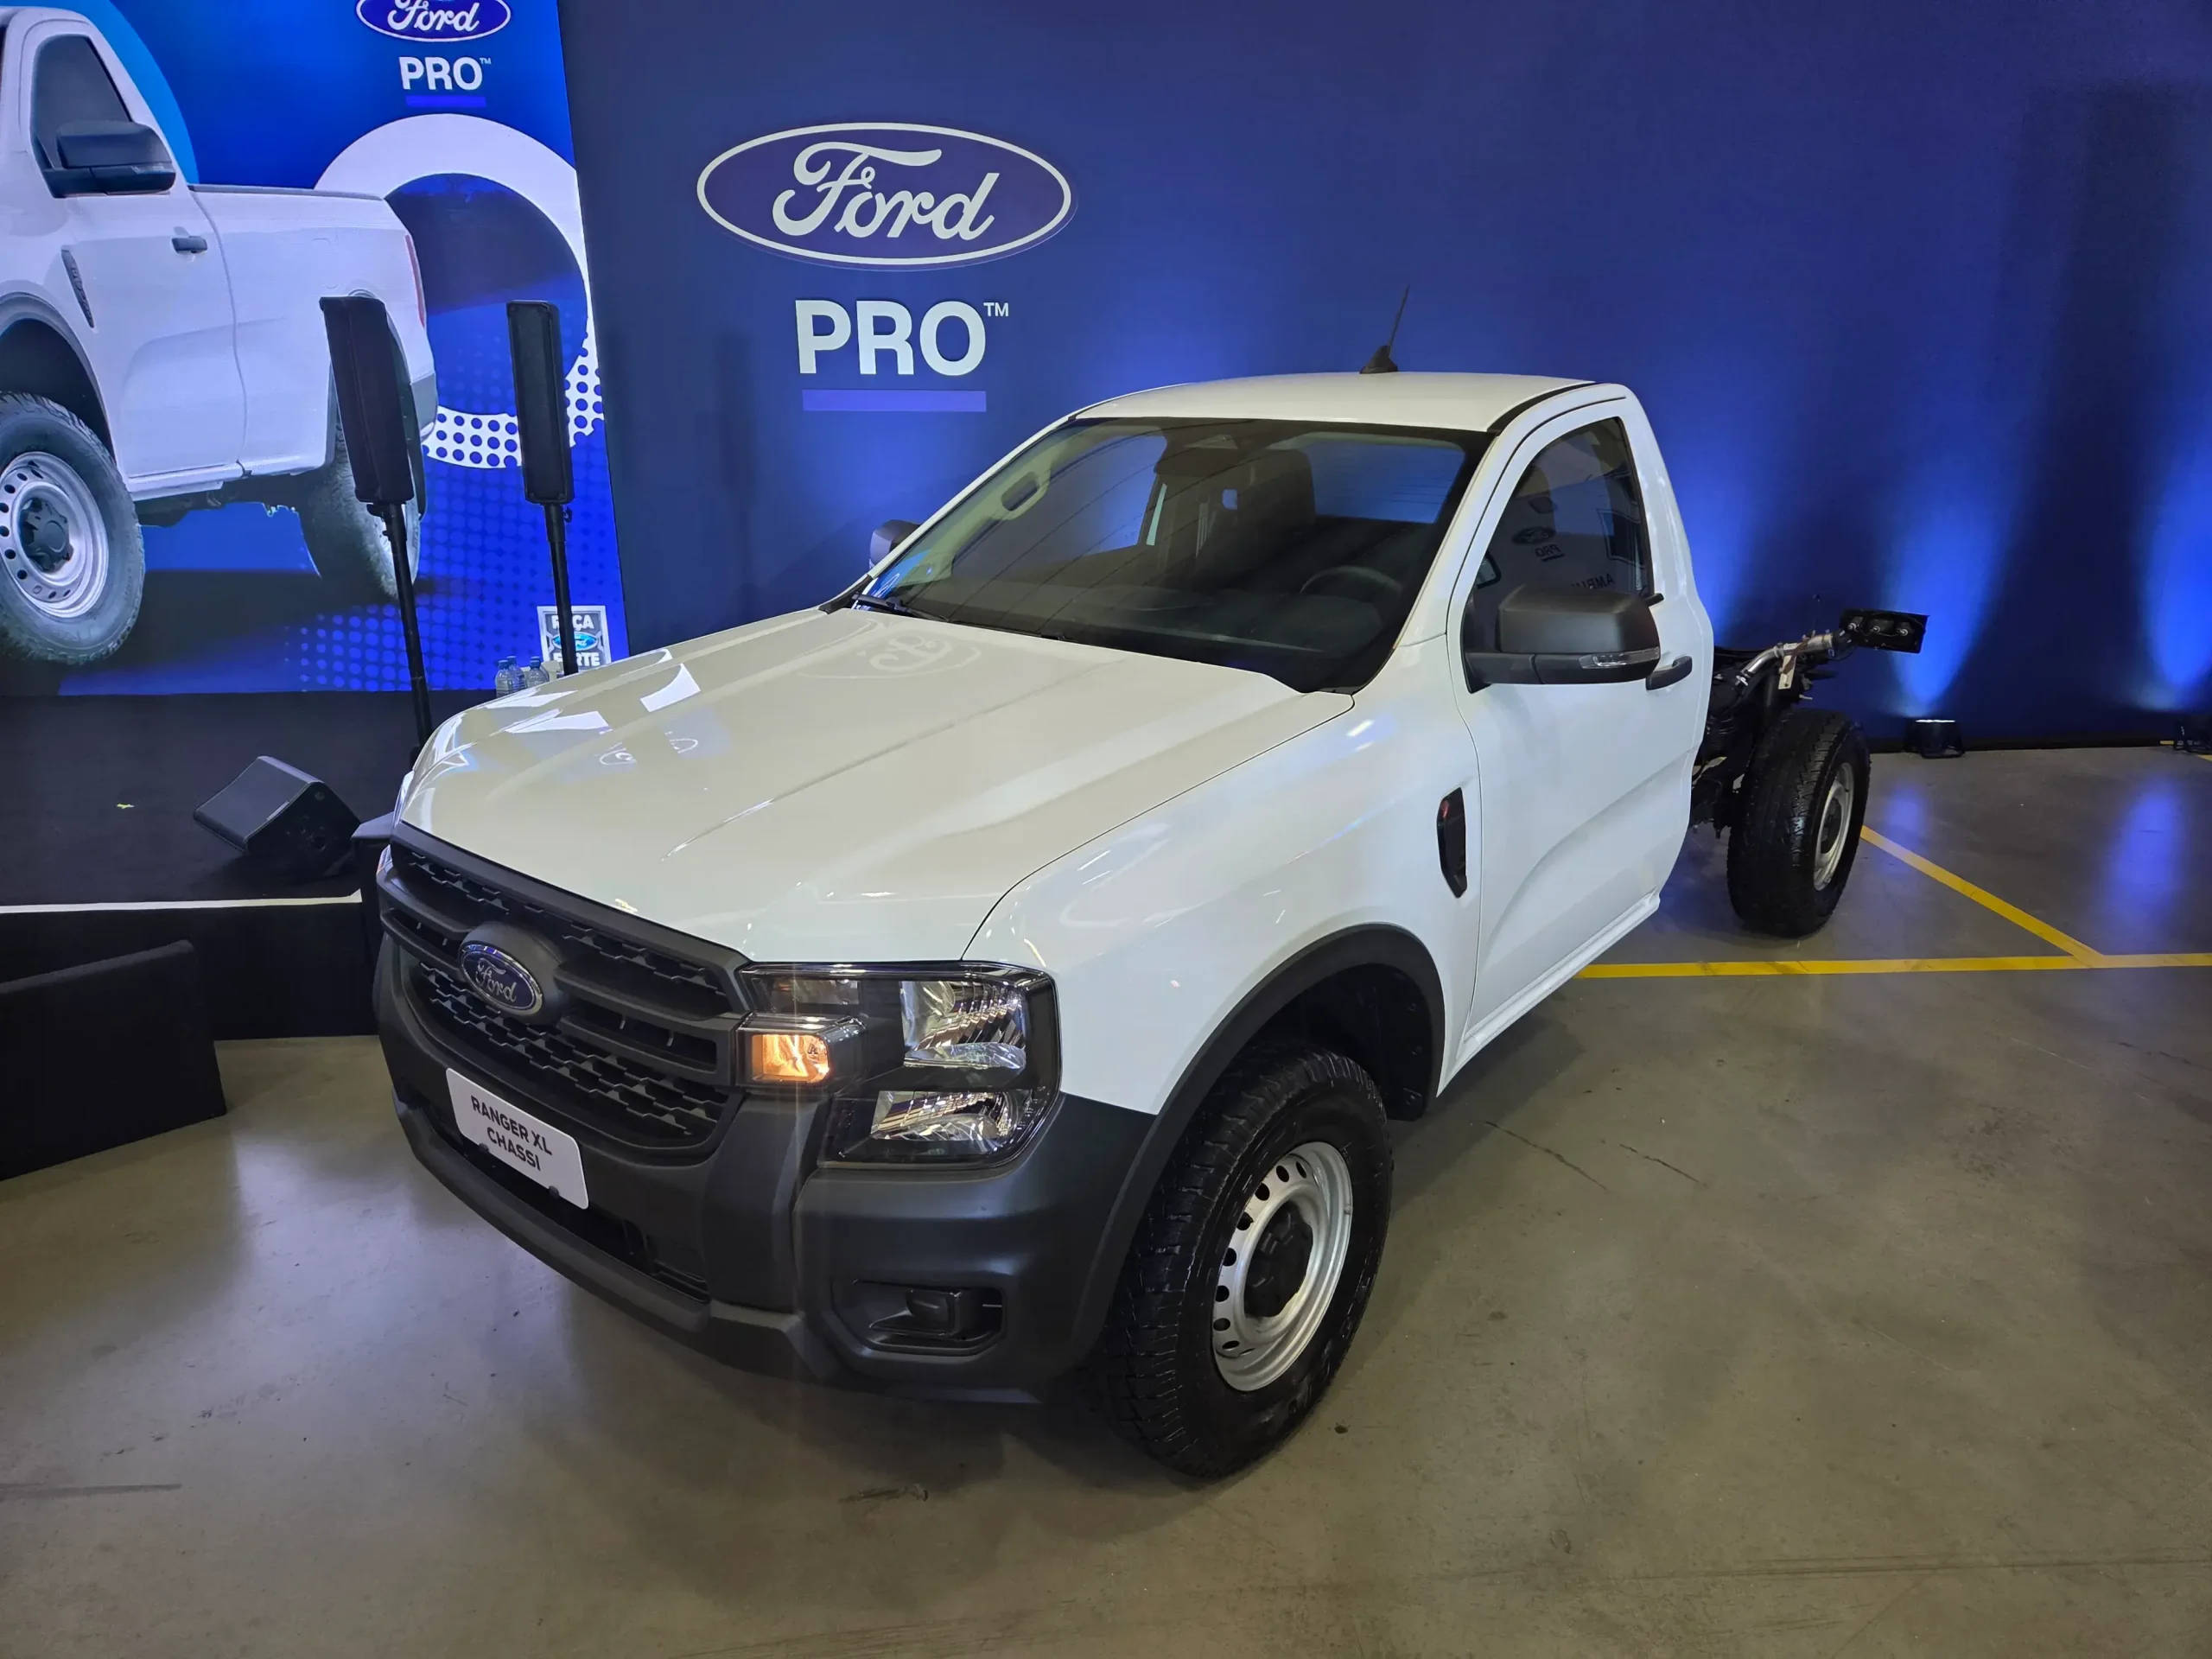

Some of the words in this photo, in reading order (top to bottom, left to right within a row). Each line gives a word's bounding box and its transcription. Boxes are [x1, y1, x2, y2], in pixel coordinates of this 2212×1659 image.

[387, 0, 480, 32] Ford
[772, 141, 1000, 241] Ford
[550, 614, 594, 632] RÇA
[553, 652, 601, 667] FRTE
[474, 957, 517, 1004] Ford
[470, 1095, 531, 1144] RANGER
[531, 1129, 553, 1156] XL
[486, 1127, 542, 1172] CHASSI
